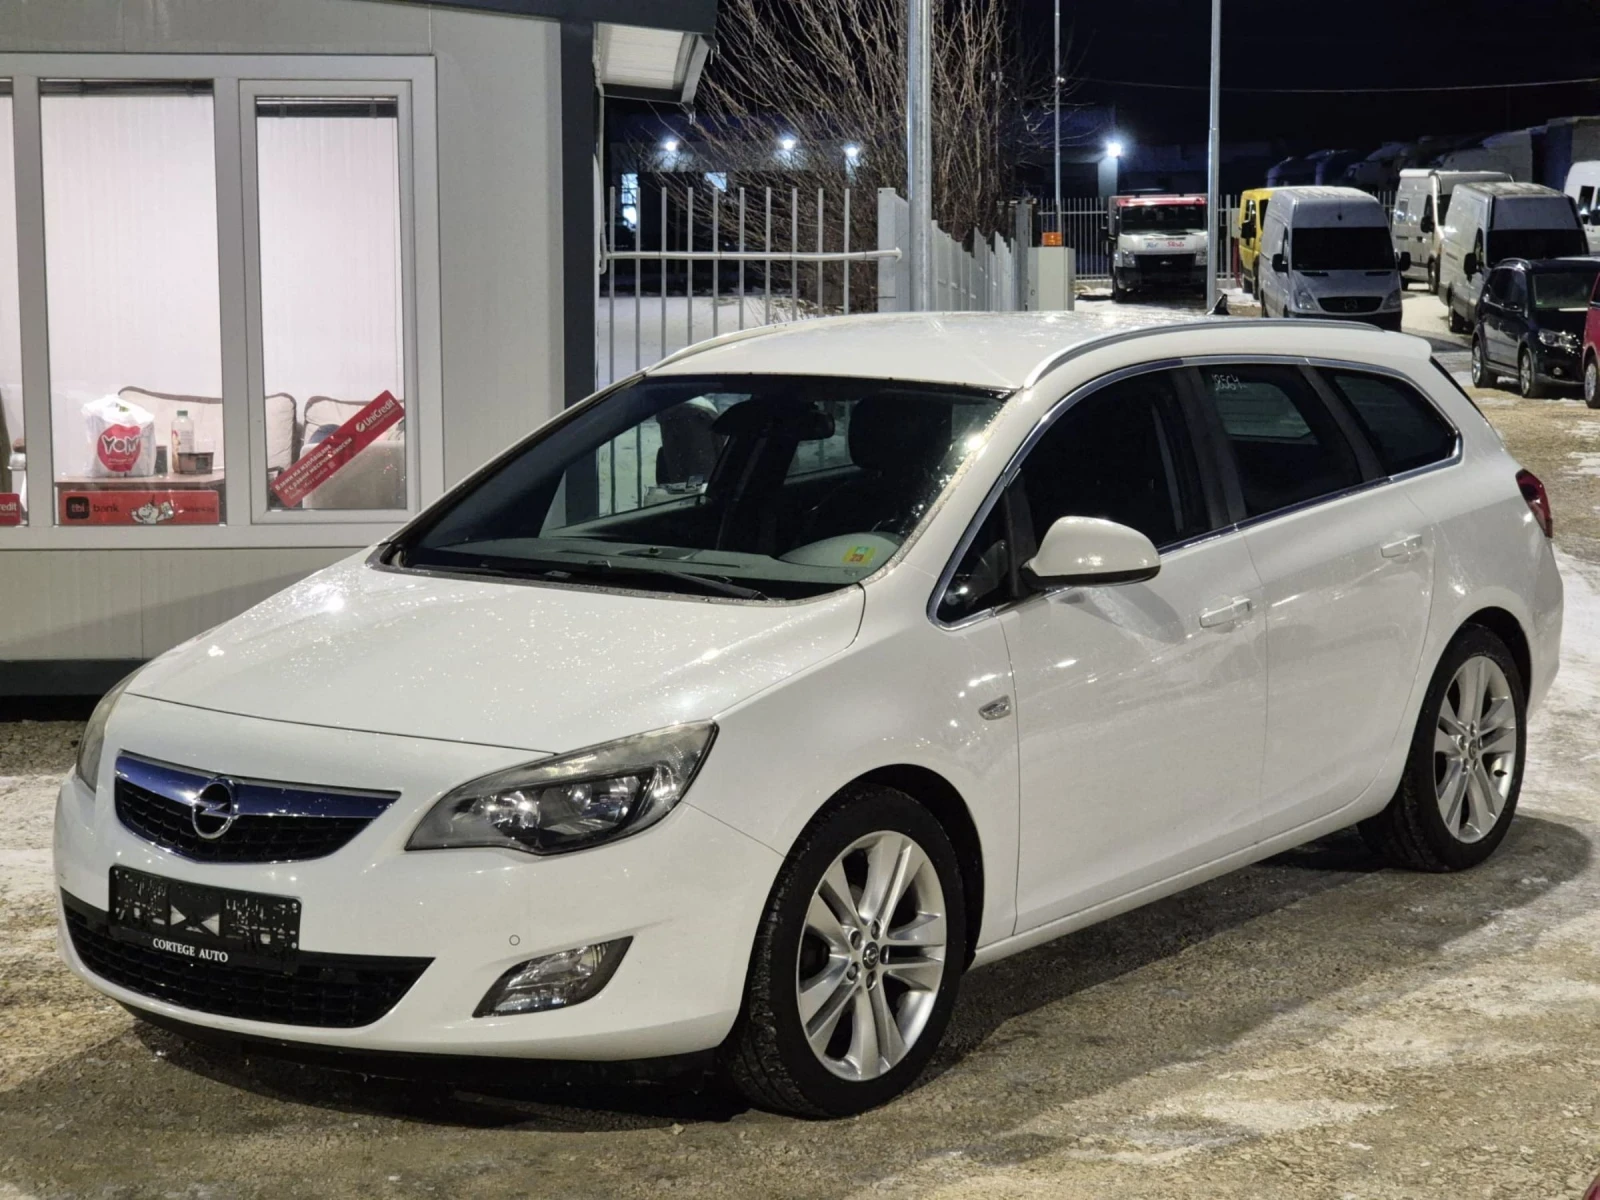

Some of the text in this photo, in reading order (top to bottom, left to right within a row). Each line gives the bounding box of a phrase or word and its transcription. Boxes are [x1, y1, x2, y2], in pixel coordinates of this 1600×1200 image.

[363, 399, 395, 426] UniCredit
[275, 475, 293, 490] Вземи
[293, 469, 301, 477] на
[300, 444, 332, 473] изплащане
[309, 453, 333, 474] месечн
[93, 503, 120, 513] bank
[153, 937, 228, 963] CORTEGE AUTO
